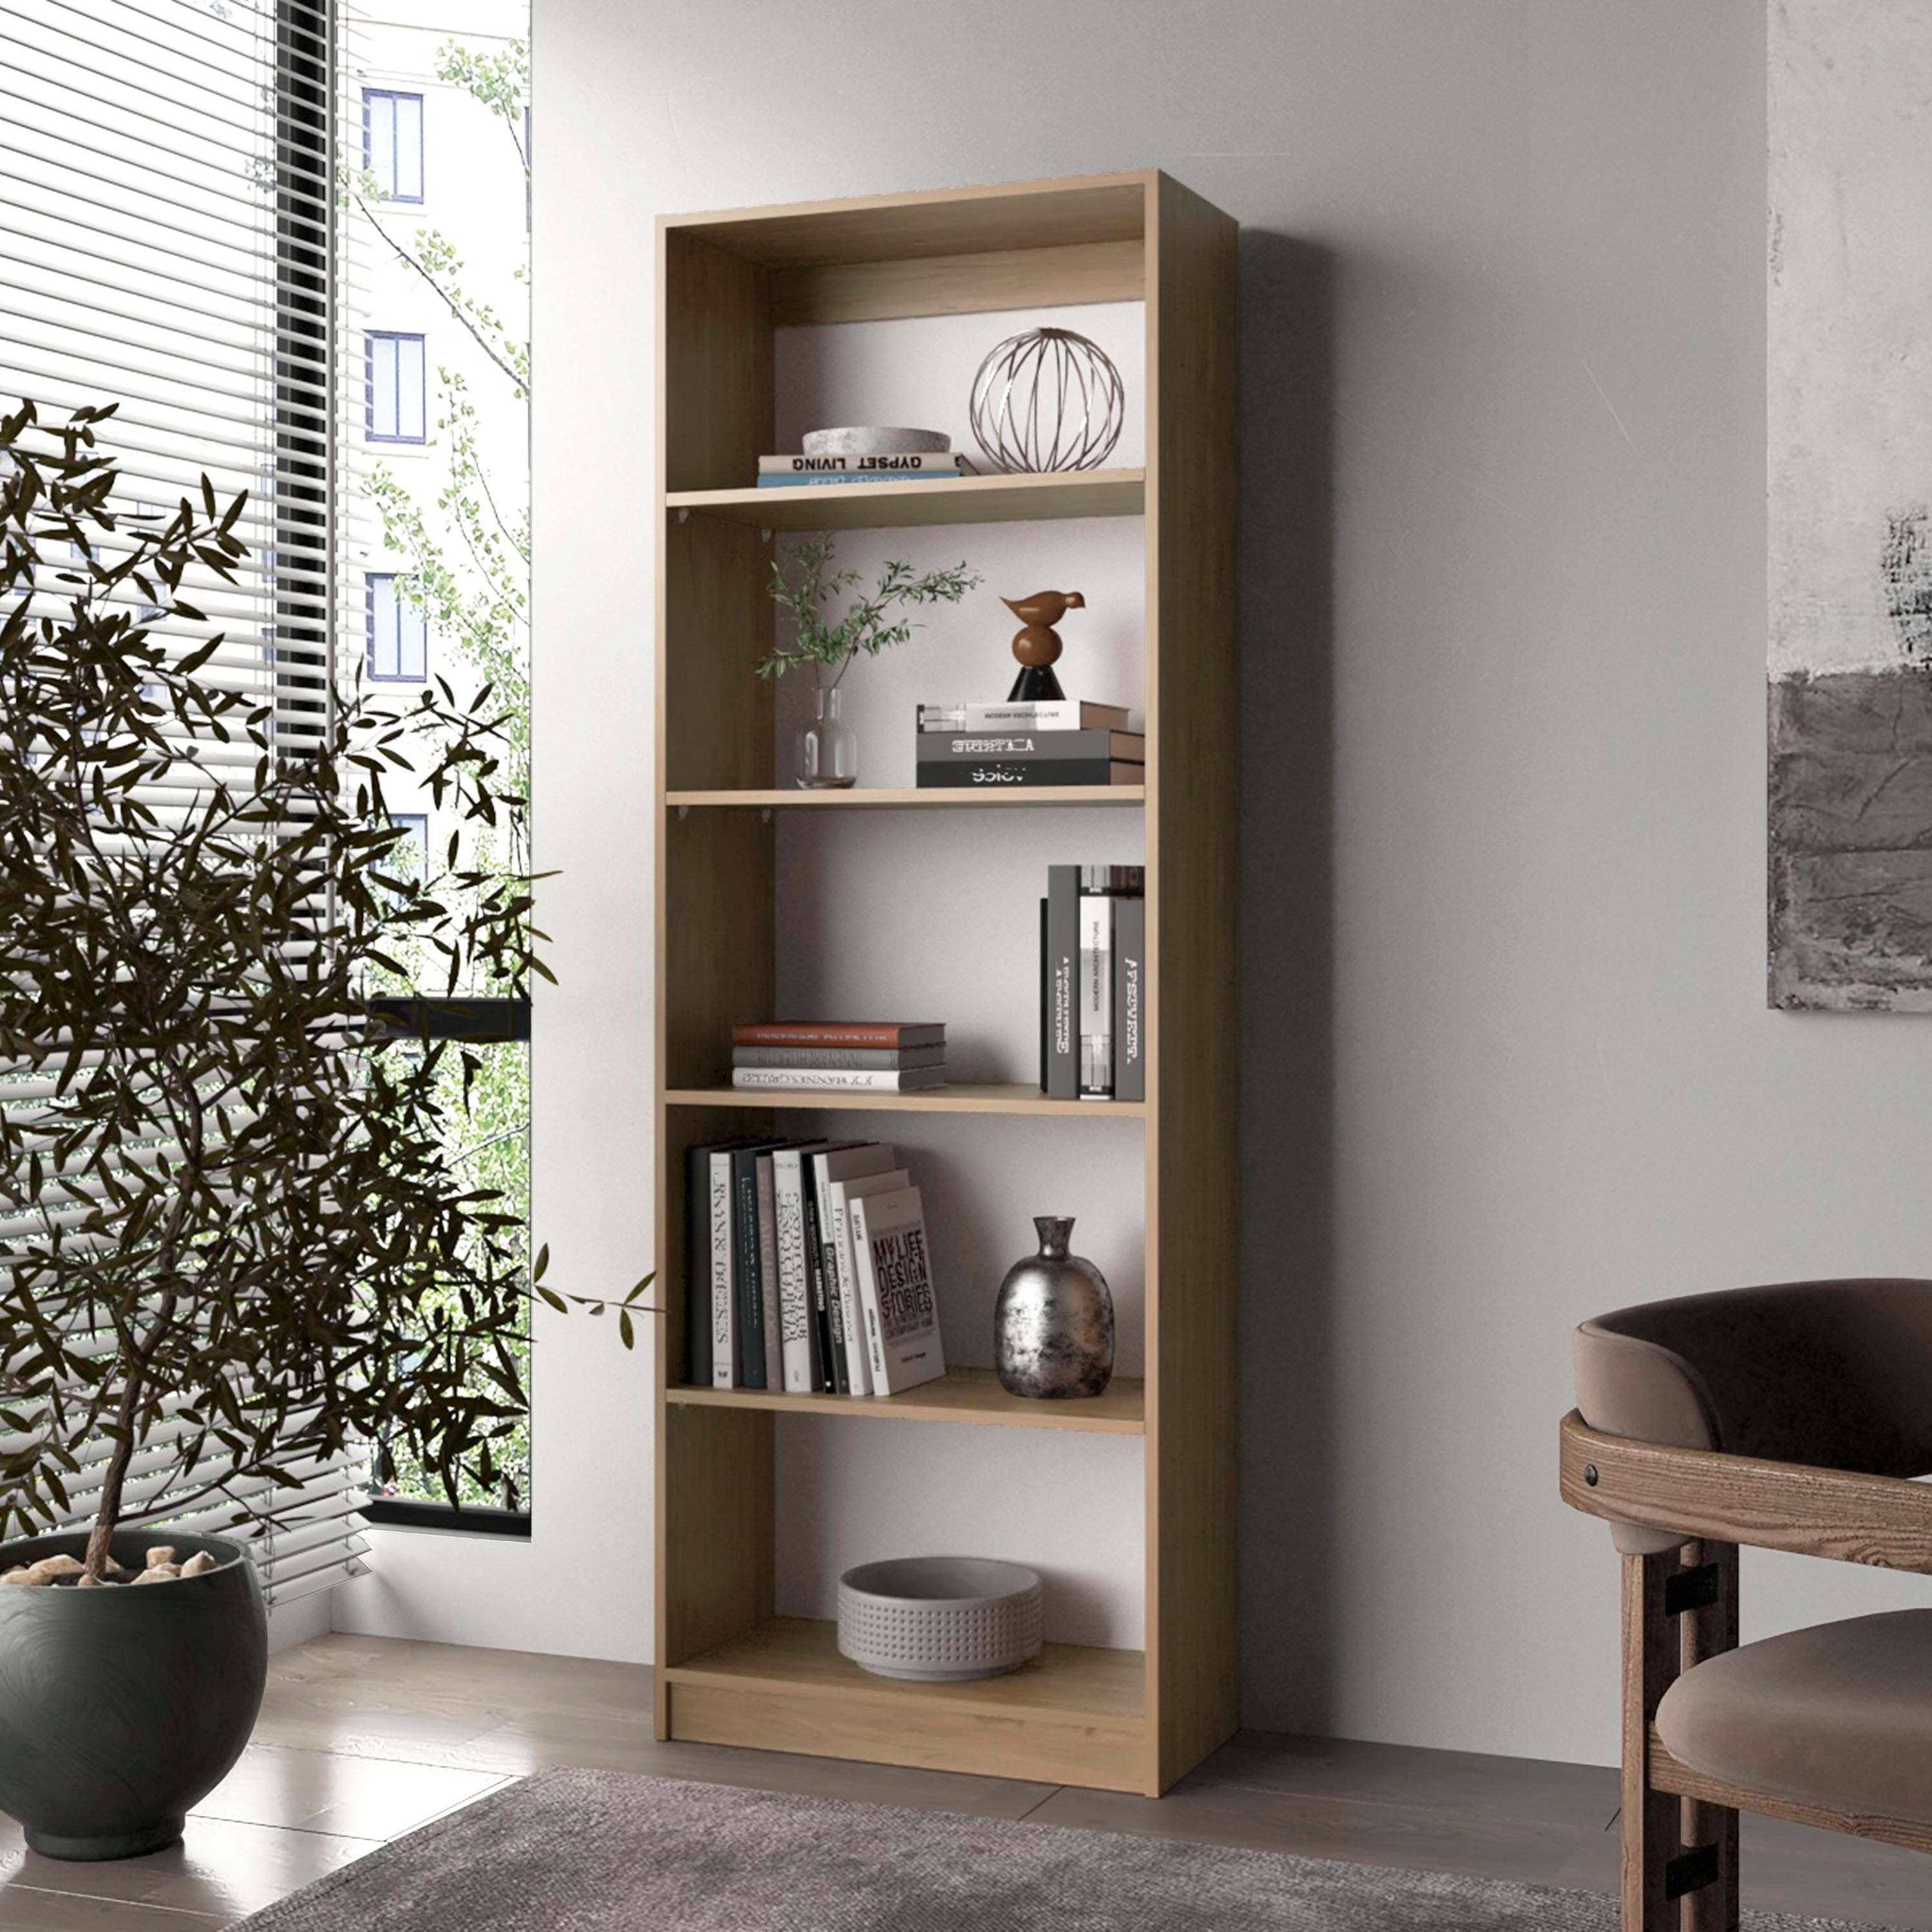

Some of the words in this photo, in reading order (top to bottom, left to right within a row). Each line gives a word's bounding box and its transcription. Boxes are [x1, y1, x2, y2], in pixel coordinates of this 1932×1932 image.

[792, 458, 846, 471] LIVING
[858, 456, 922, 469] GYPSET
[815, 1268, 825, 1312] MARKETING
[826, 1246, 838, 1296] Graphic
[878, 1253, 927, 1294] DESIGN
[881, 1282, 933, 1318] STORIES
[831, 1300, 842, 1344] Design
